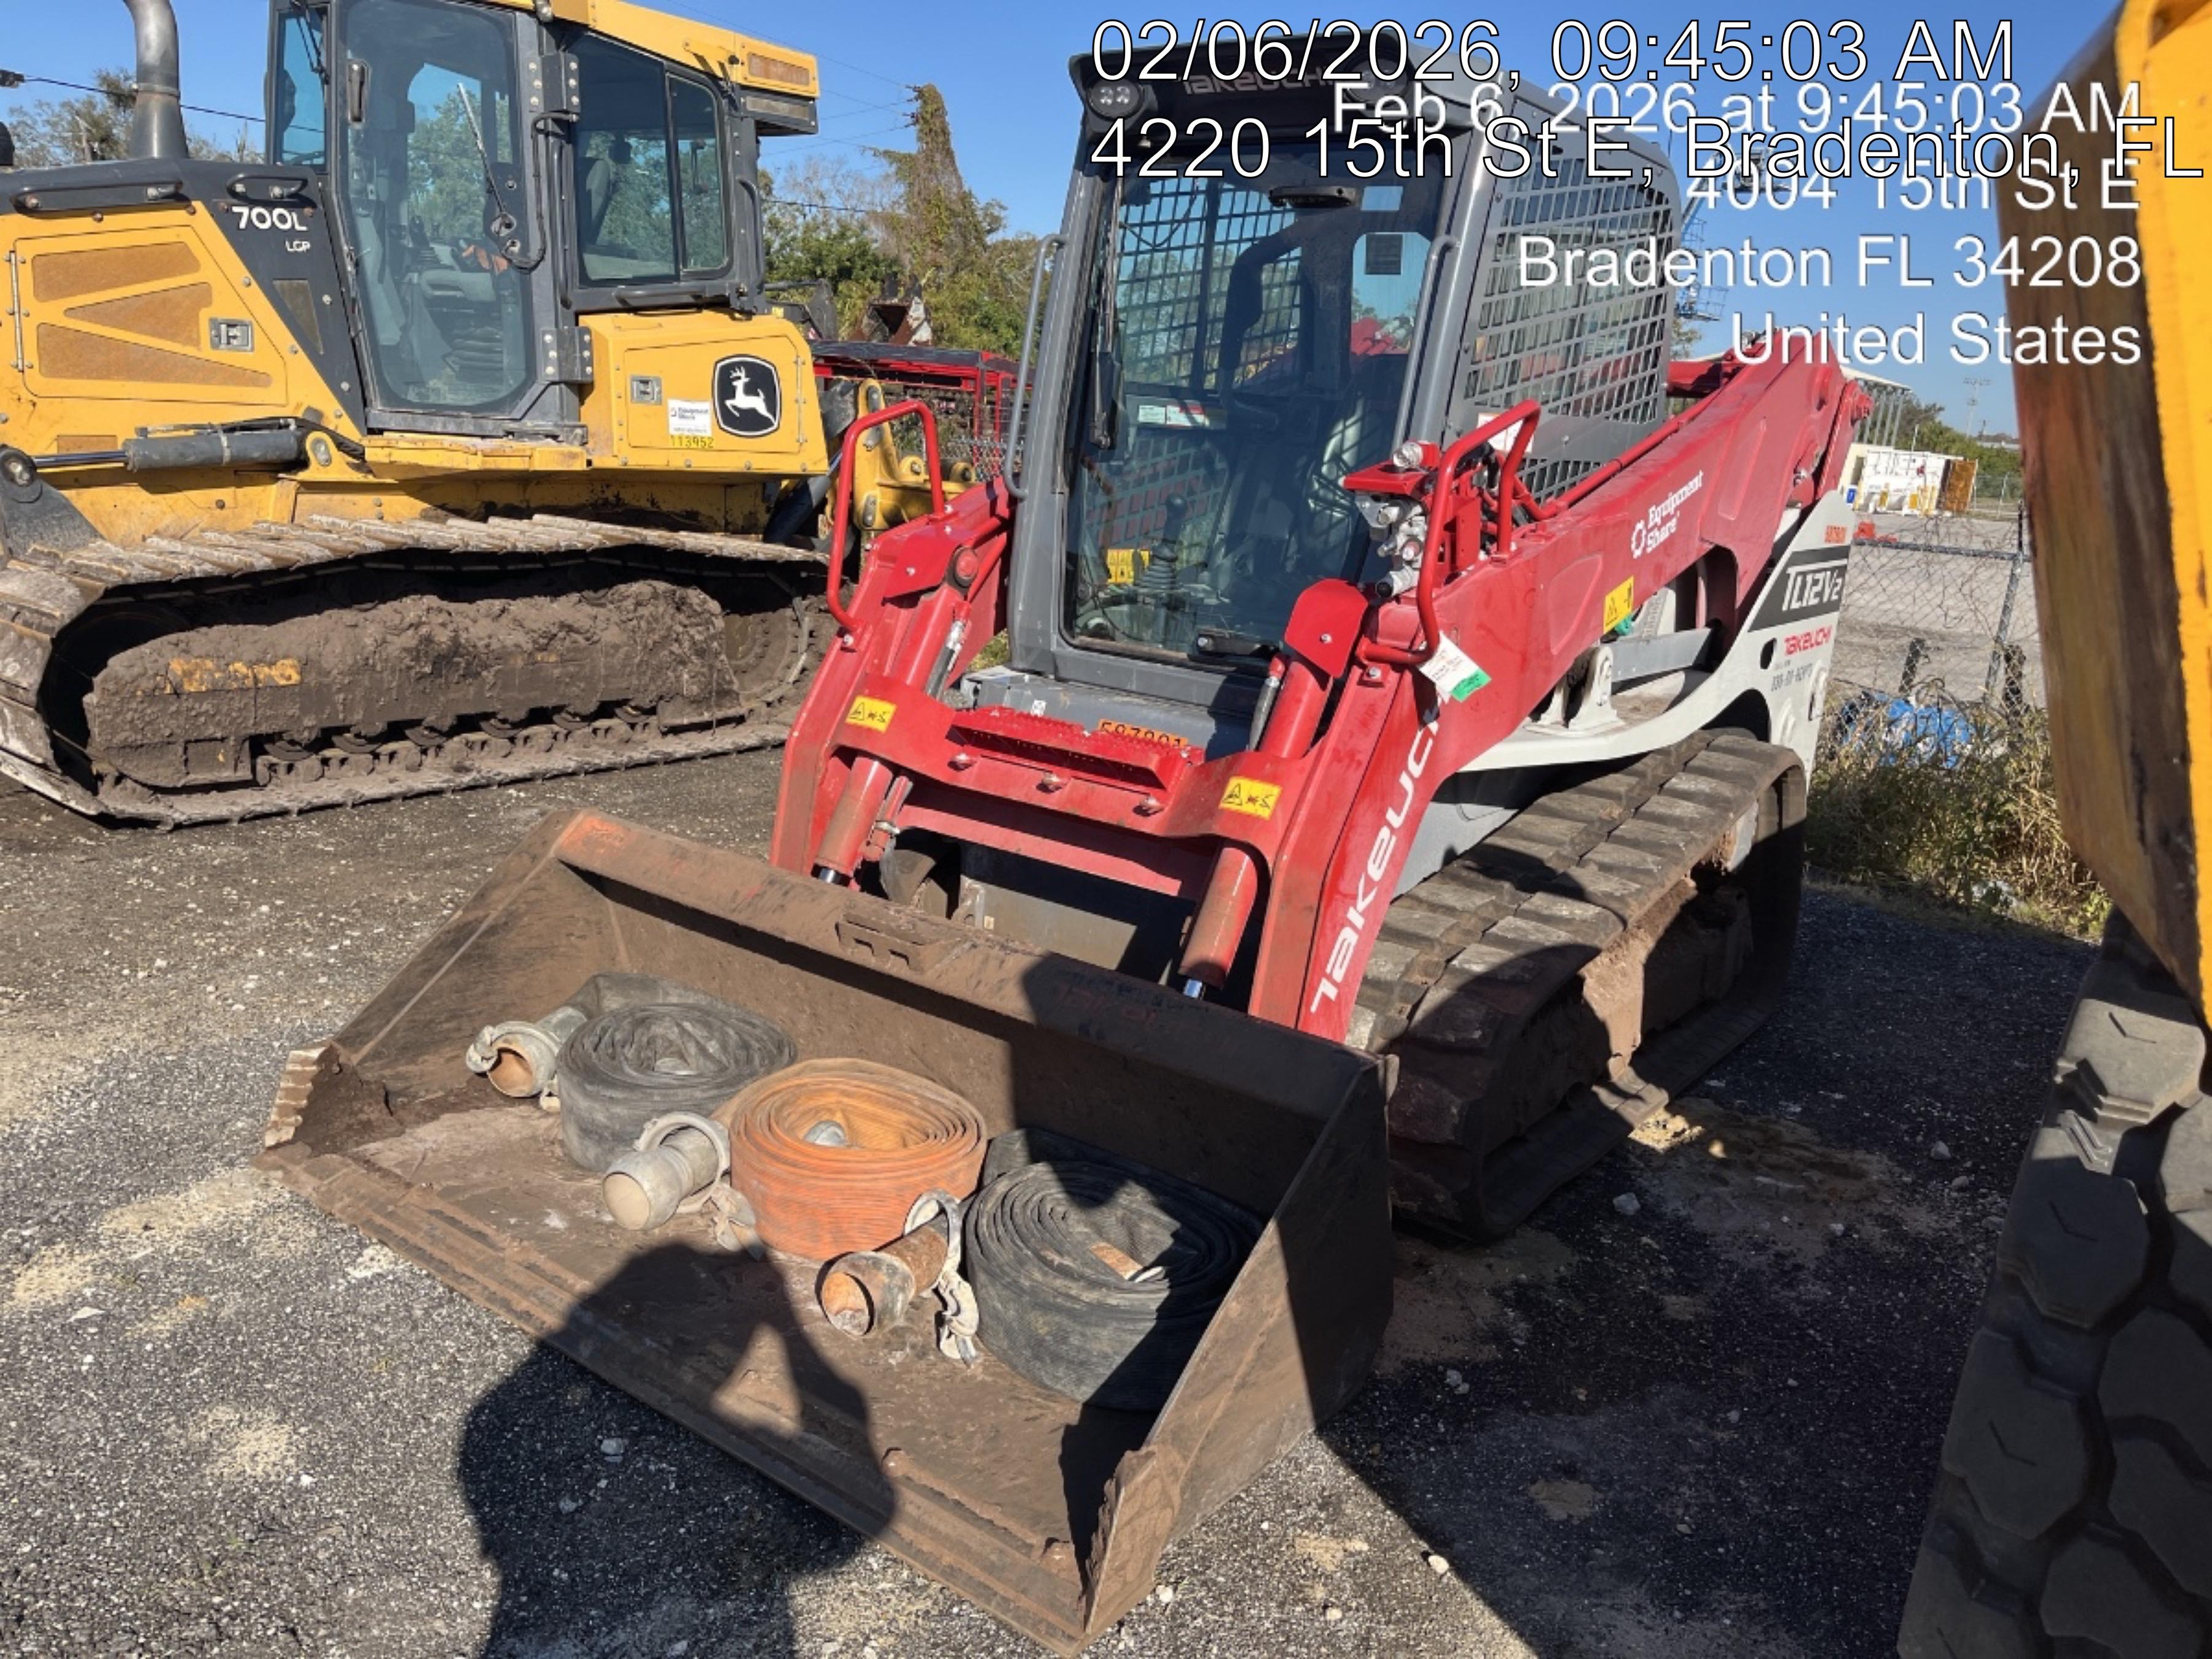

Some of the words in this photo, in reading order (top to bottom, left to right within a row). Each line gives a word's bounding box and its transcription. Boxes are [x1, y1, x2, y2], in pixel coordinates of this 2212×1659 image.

[232, 206, 308, 231] 700L
[1647, 470, 1704, 530] Equipment
[1646, 516, 1678, 554] Share
